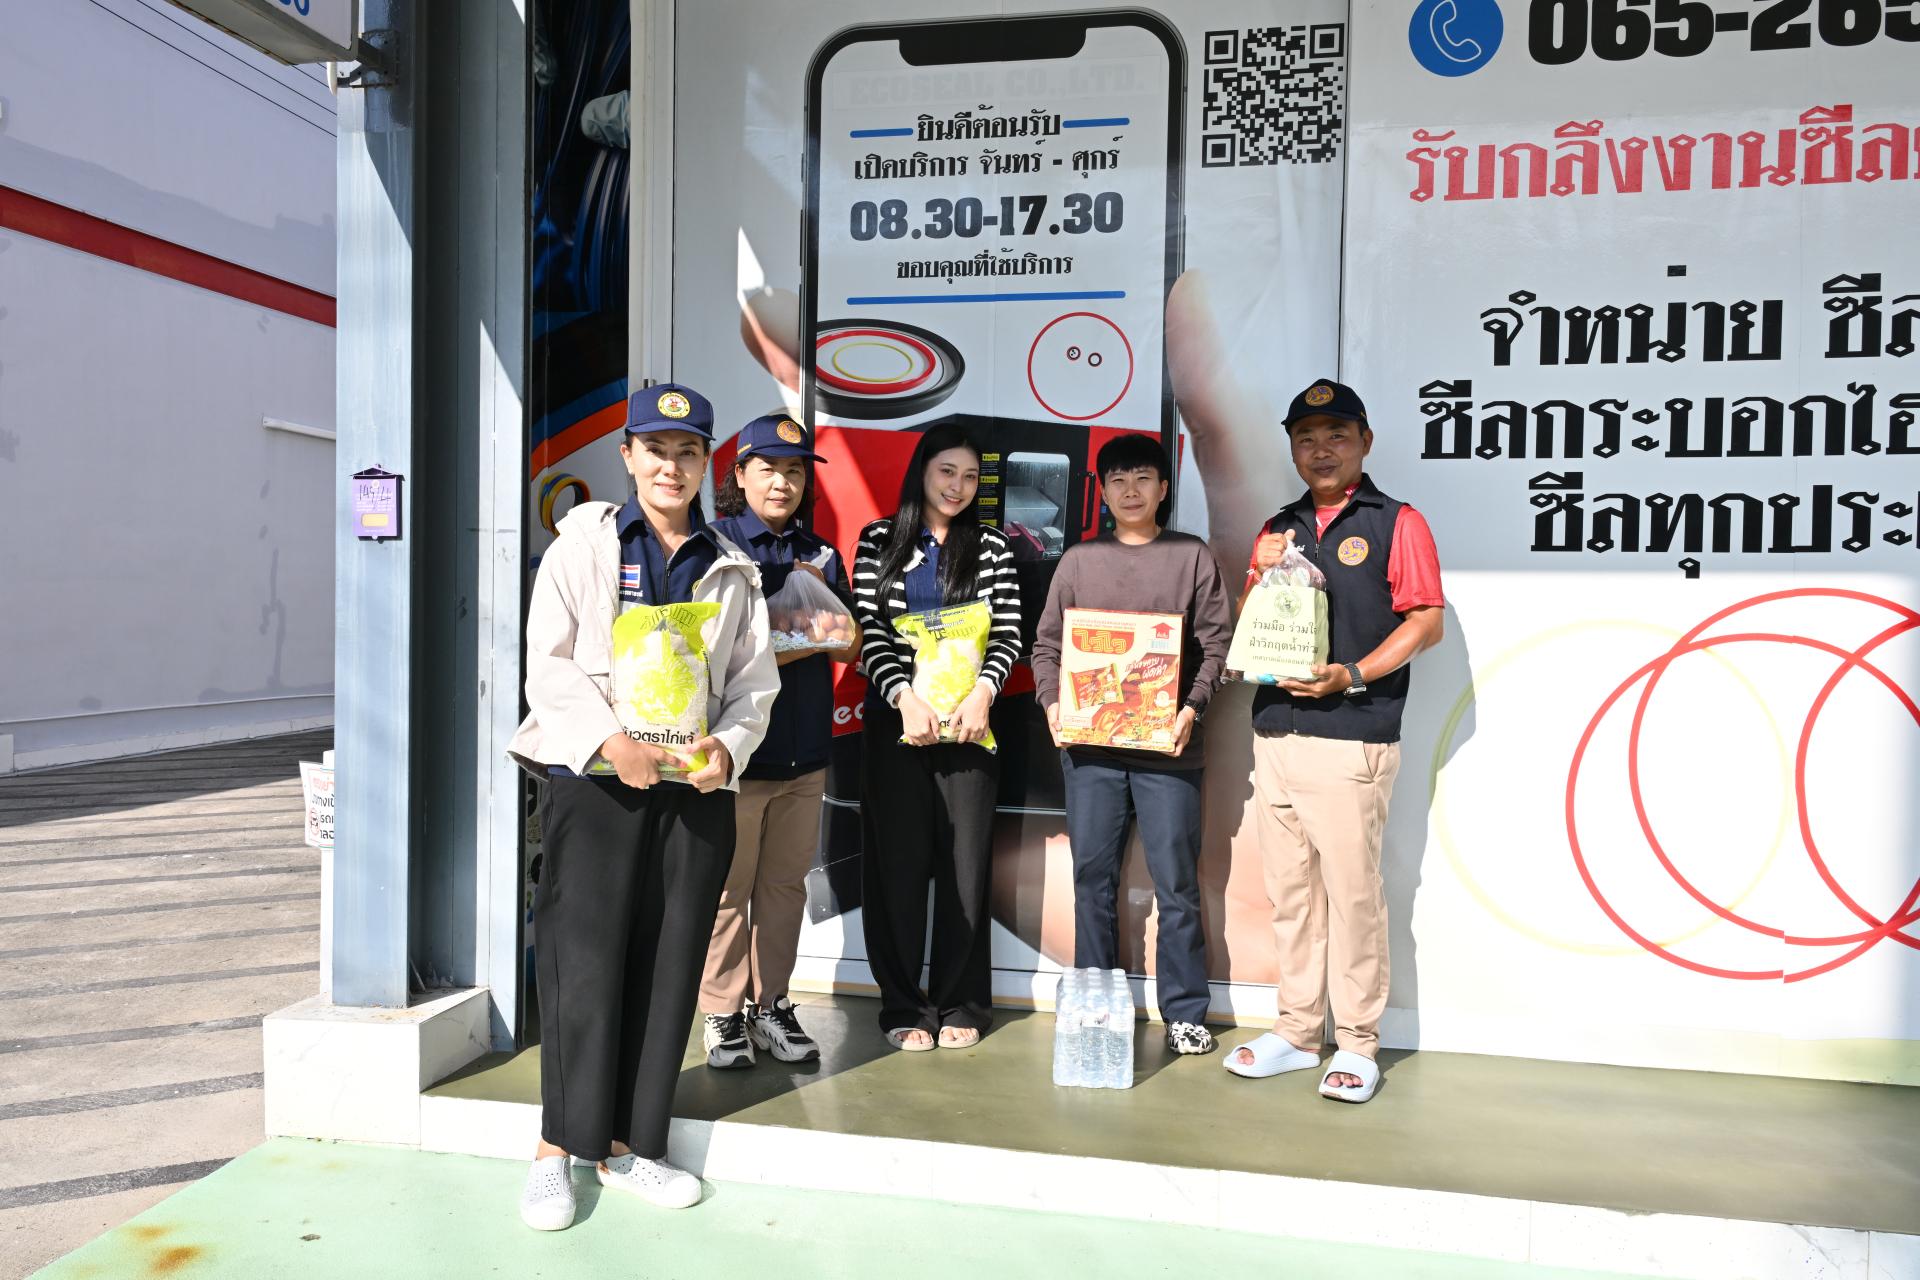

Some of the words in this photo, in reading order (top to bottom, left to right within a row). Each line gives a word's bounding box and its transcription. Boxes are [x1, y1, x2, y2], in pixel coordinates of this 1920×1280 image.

[917, 104, 1061, 142] ยินดีต้อนรับ
[854, 151, 968, 180] เปิดบริการ
[980, 139, 1046, 175] จันทร์
[1072, 136, 1124, 179] ศุกร์
[1406, 104, 1920, 202] รับกลึงงานซีล
[850, 192, 1124, 241] 08.30-17.30
[896, 248, 1074, 285] ขอบคุณที่ใช้บริการ
[1480, 265, 1783, 366] จำหน่าย
[1528, 471, 1920, 579] ซีลทุกประ
